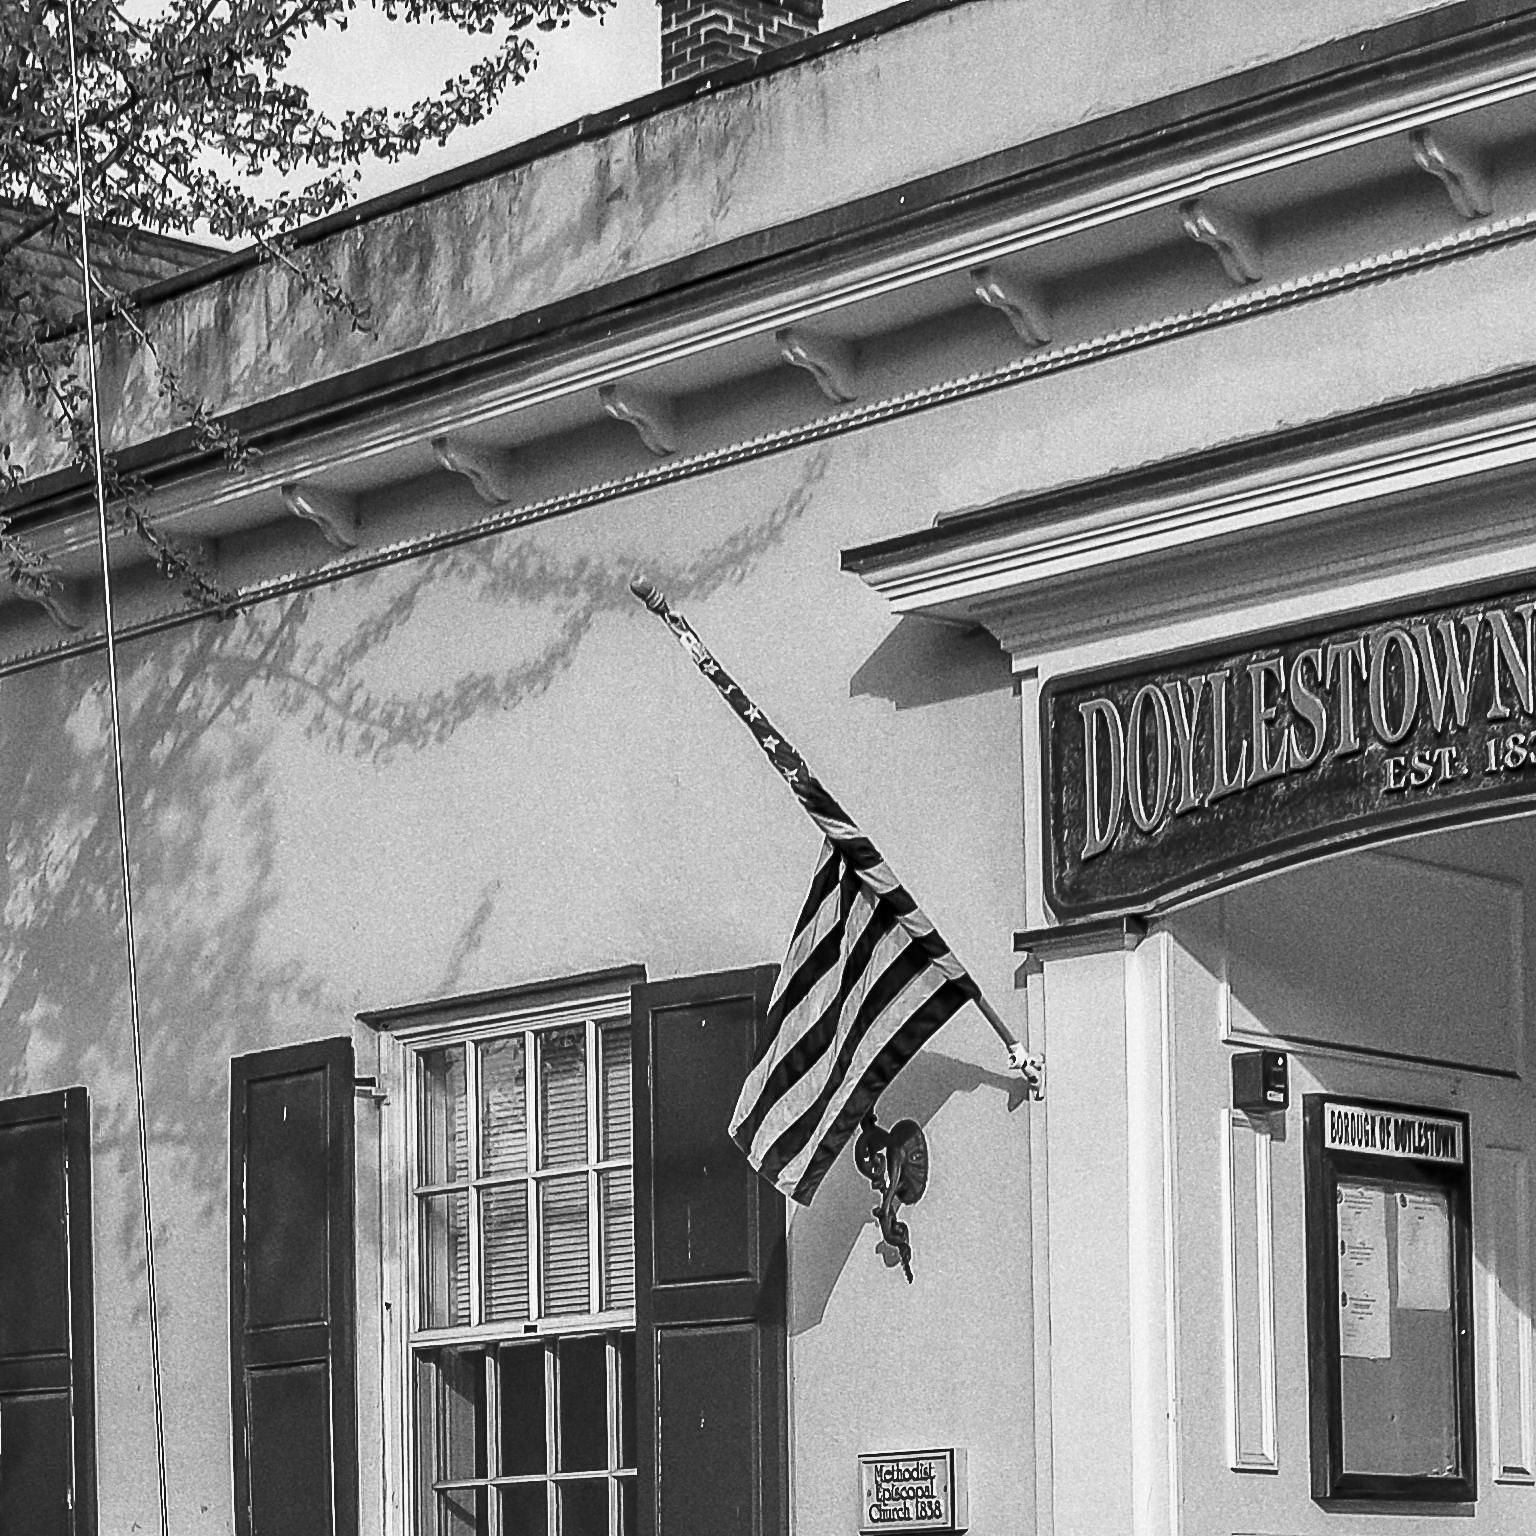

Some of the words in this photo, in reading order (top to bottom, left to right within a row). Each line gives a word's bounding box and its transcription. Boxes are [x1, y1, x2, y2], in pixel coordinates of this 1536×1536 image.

[1382, 746, 1470, 794] EST.
[1330, 1109, 1377, 1148] BOROUGH
[1379, 1115, 1392, 1151] OF
[875, 1461, 937, 1483] Methodist
[875, 1479, 937, 1506] Episcopal
[869, 1500, 914, 1523] Church
